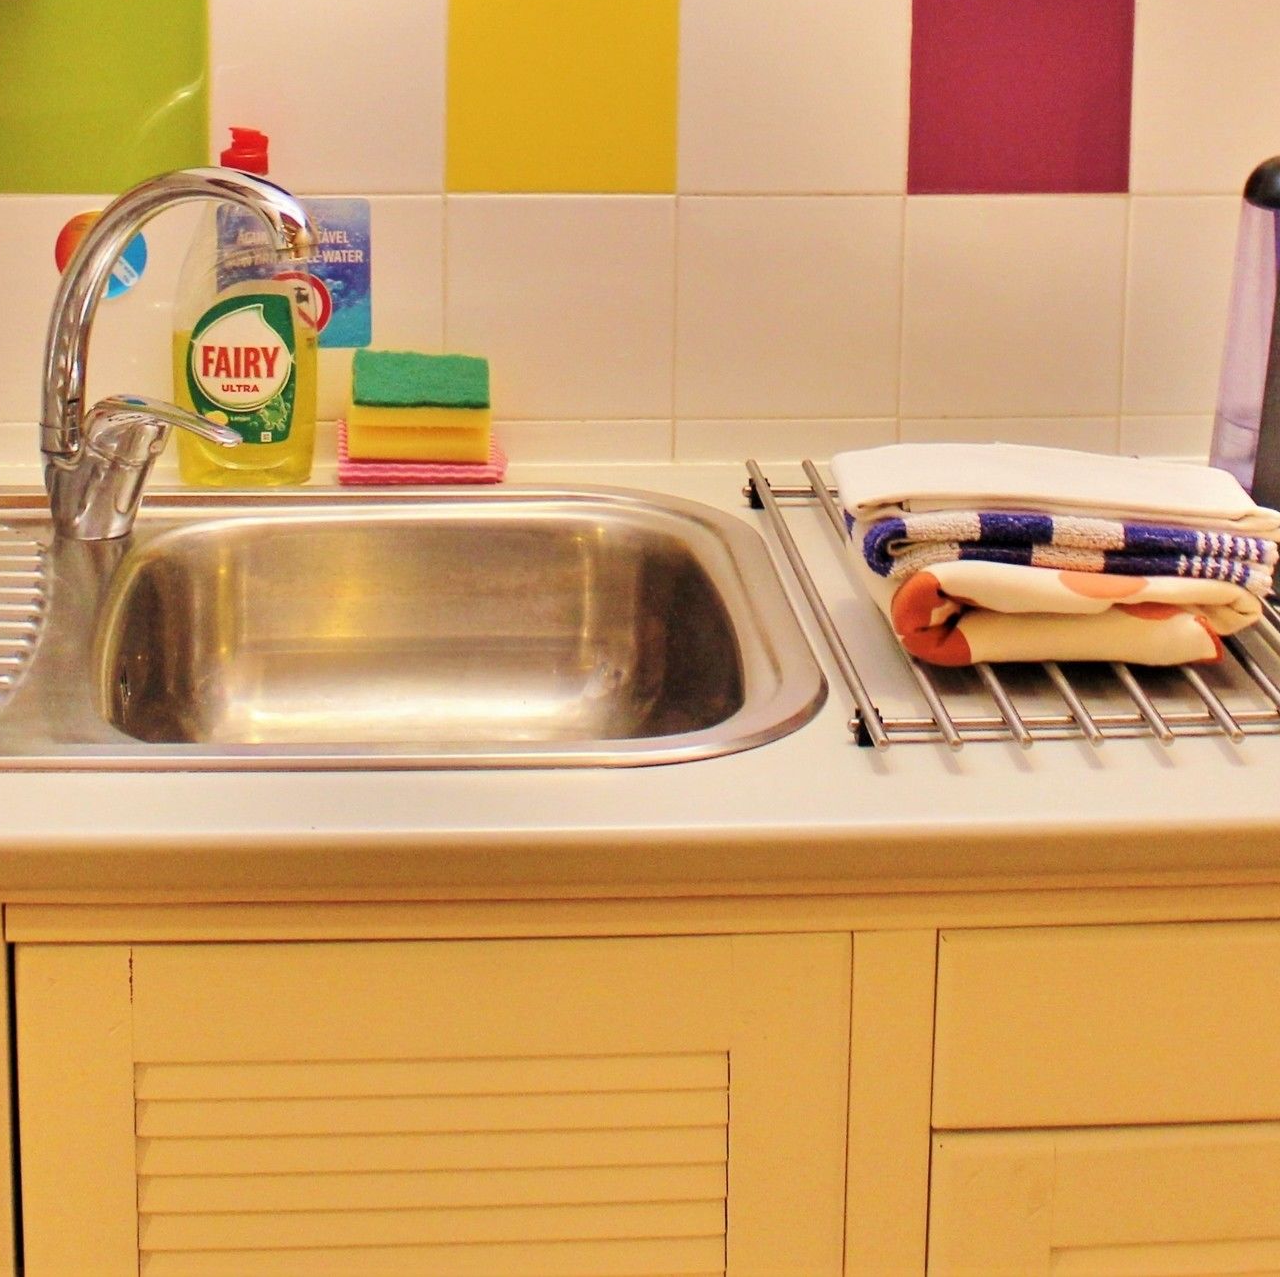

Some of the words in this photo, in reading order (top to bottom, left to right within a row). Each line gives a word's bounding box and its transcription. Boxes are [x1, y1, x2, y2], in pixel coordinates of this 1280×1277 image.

[322, 249, 364, 264] WATER
[201, 345, 281, 378] FAIRY
[221, 384, 260, 393] ULTRA
